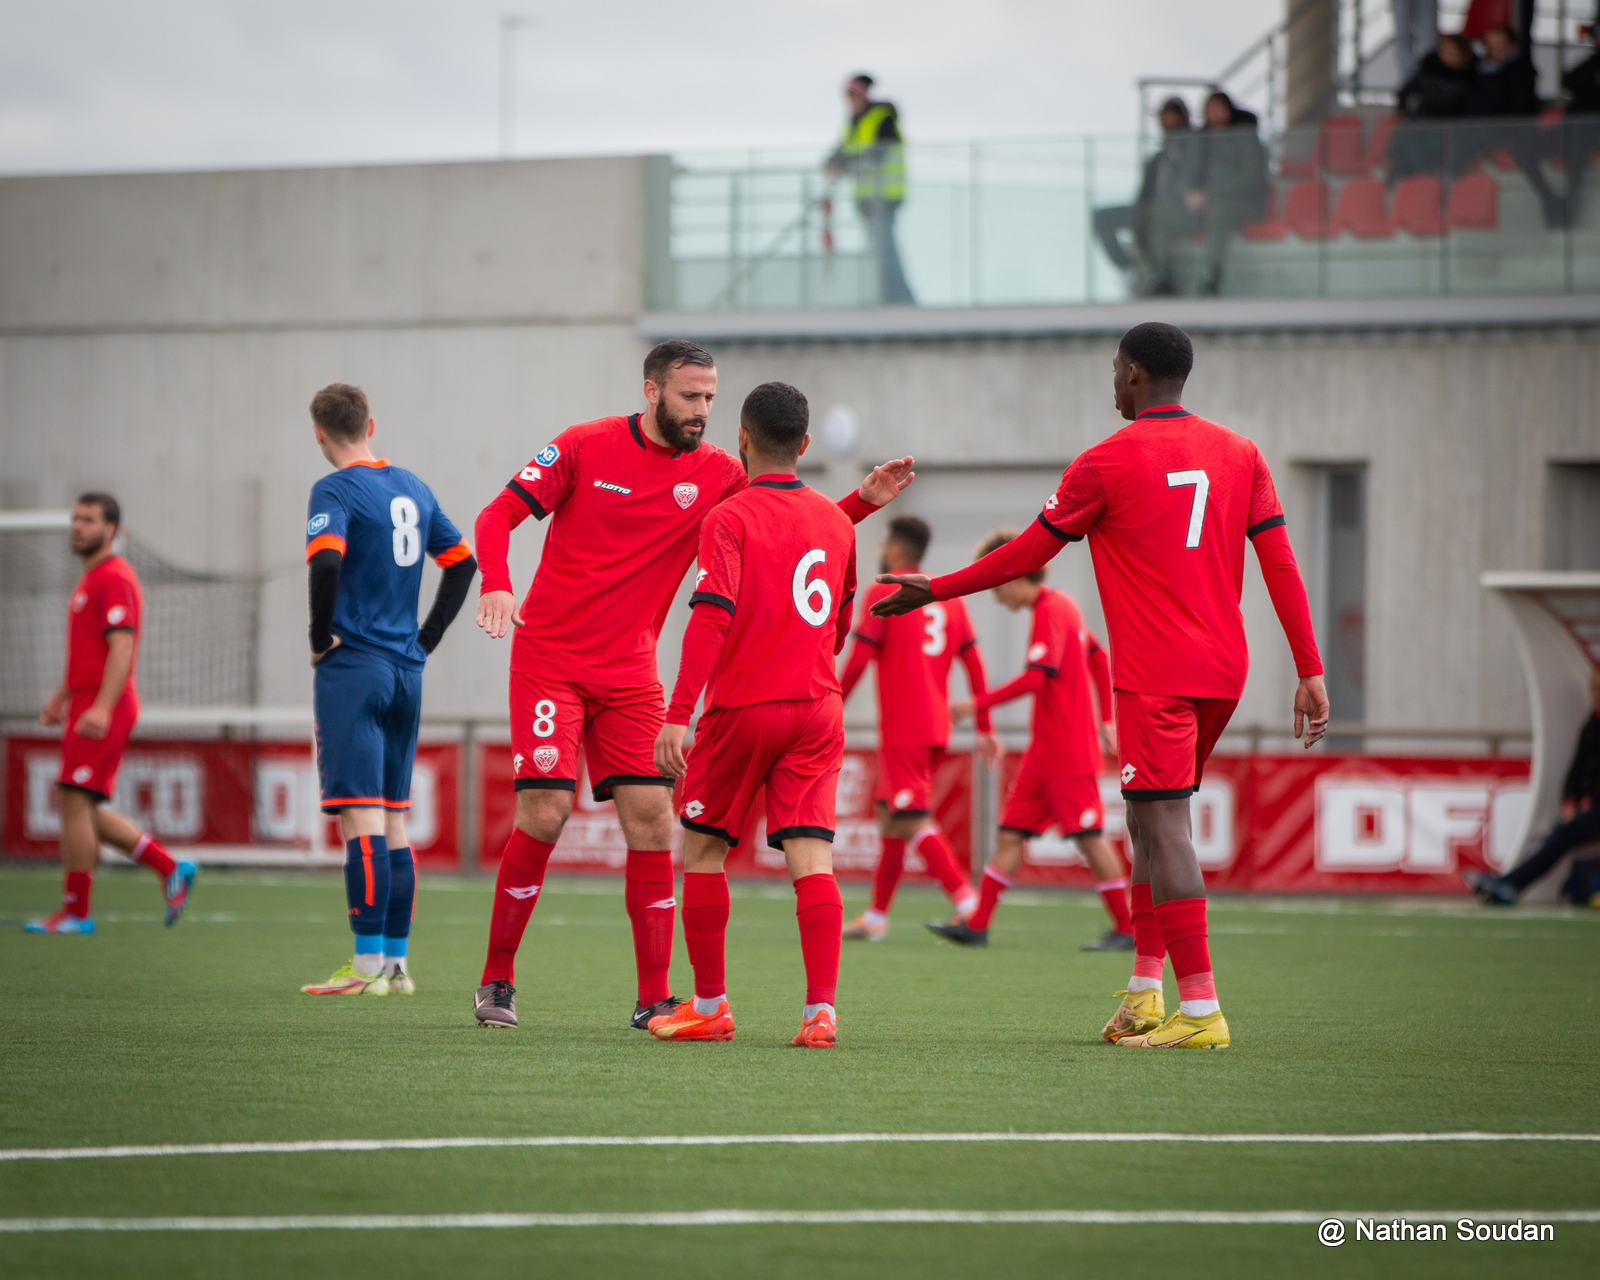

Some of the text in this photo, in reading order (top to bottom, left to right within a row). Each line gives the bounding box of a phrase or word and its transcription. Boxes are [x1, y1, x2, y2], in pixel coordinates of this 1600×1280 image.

[539, 447, 555, 461] N3
[601, 482, 632, 495] LOTTO
[1165, 469, 1210, 549] 7
[311, 517, 324, 530] N3
[390, 496, 421, 567] 8
[791, 548, 832, 628] 6
[922, 603, 947, 656] 3
[532, 699, 556, 738] 8
[25, 753, 205, 841] DCO
